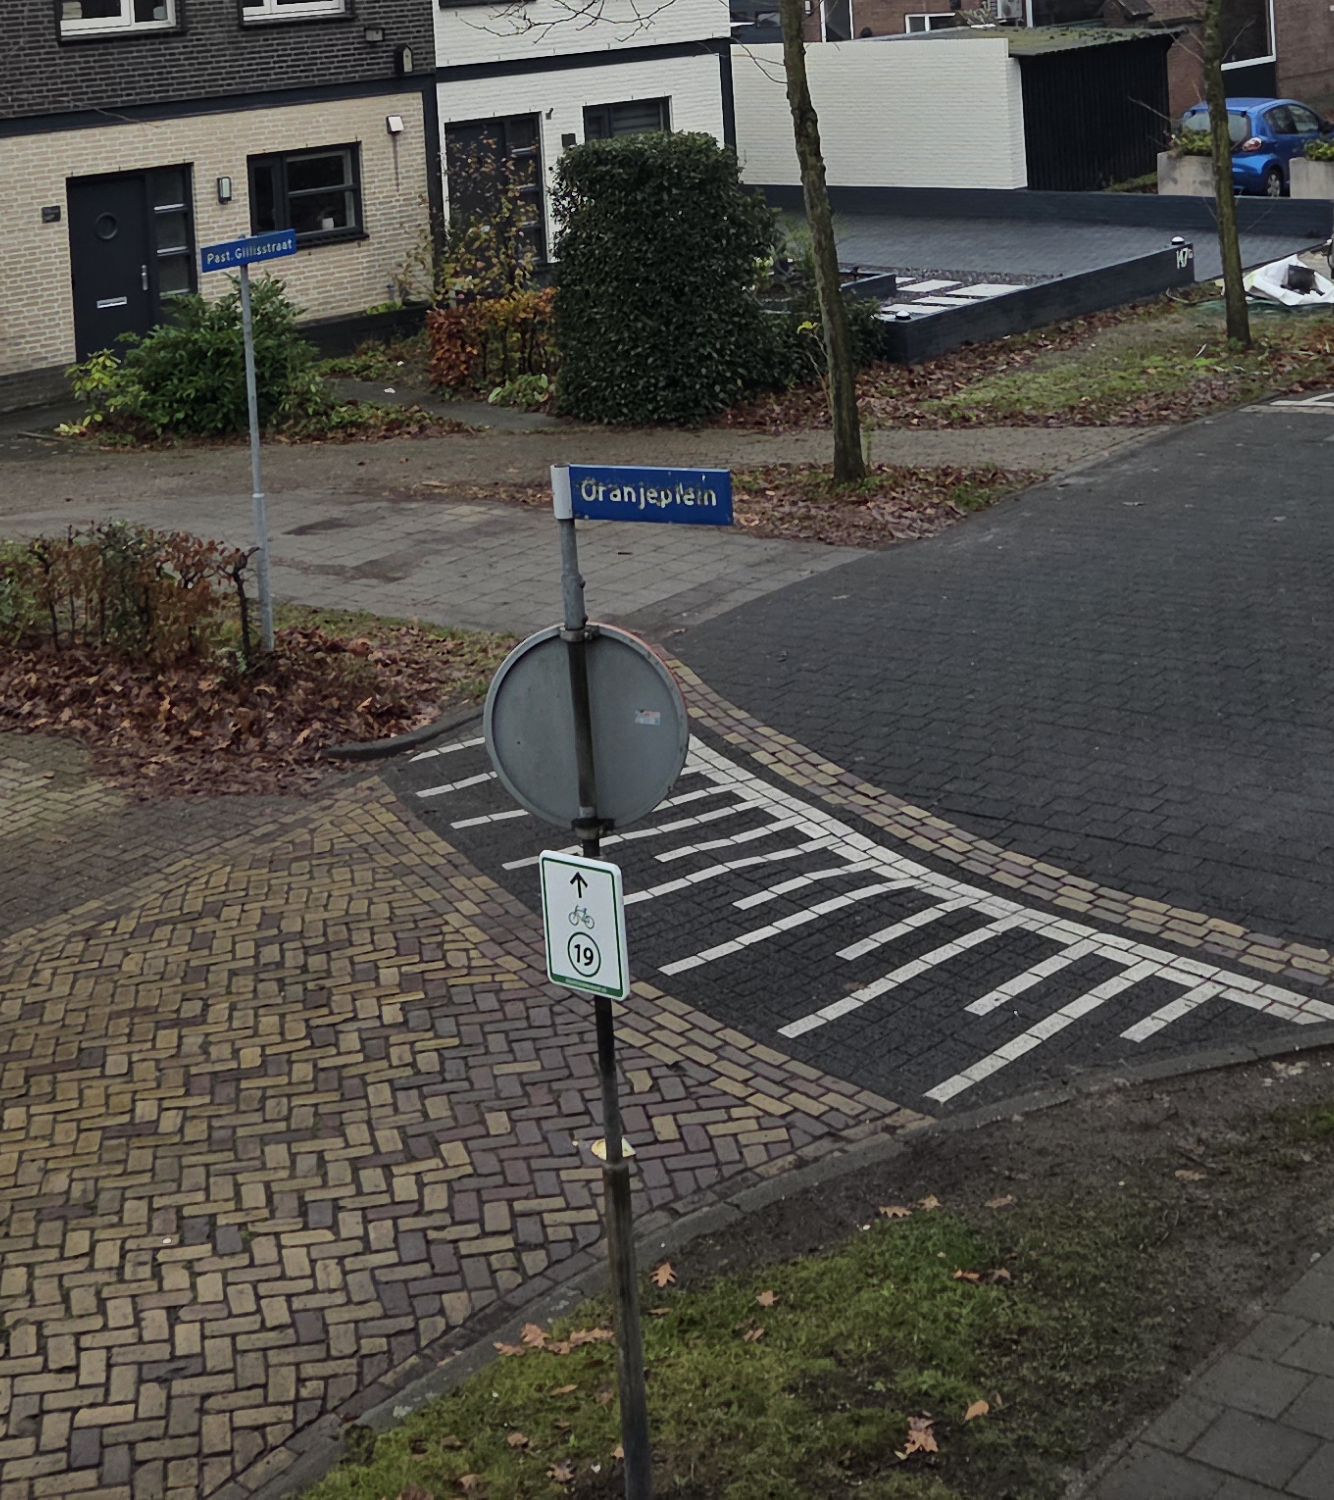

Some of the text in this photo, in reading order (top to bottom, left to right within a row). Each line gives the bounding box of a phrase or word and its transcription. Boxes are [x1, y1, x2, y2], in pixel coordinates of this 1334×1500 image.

[207, 238, 293, 265] Past. Gillisstraat
[580, 479, 717, 510] Oranjeplein
[573, 943, 595, 967] 19
